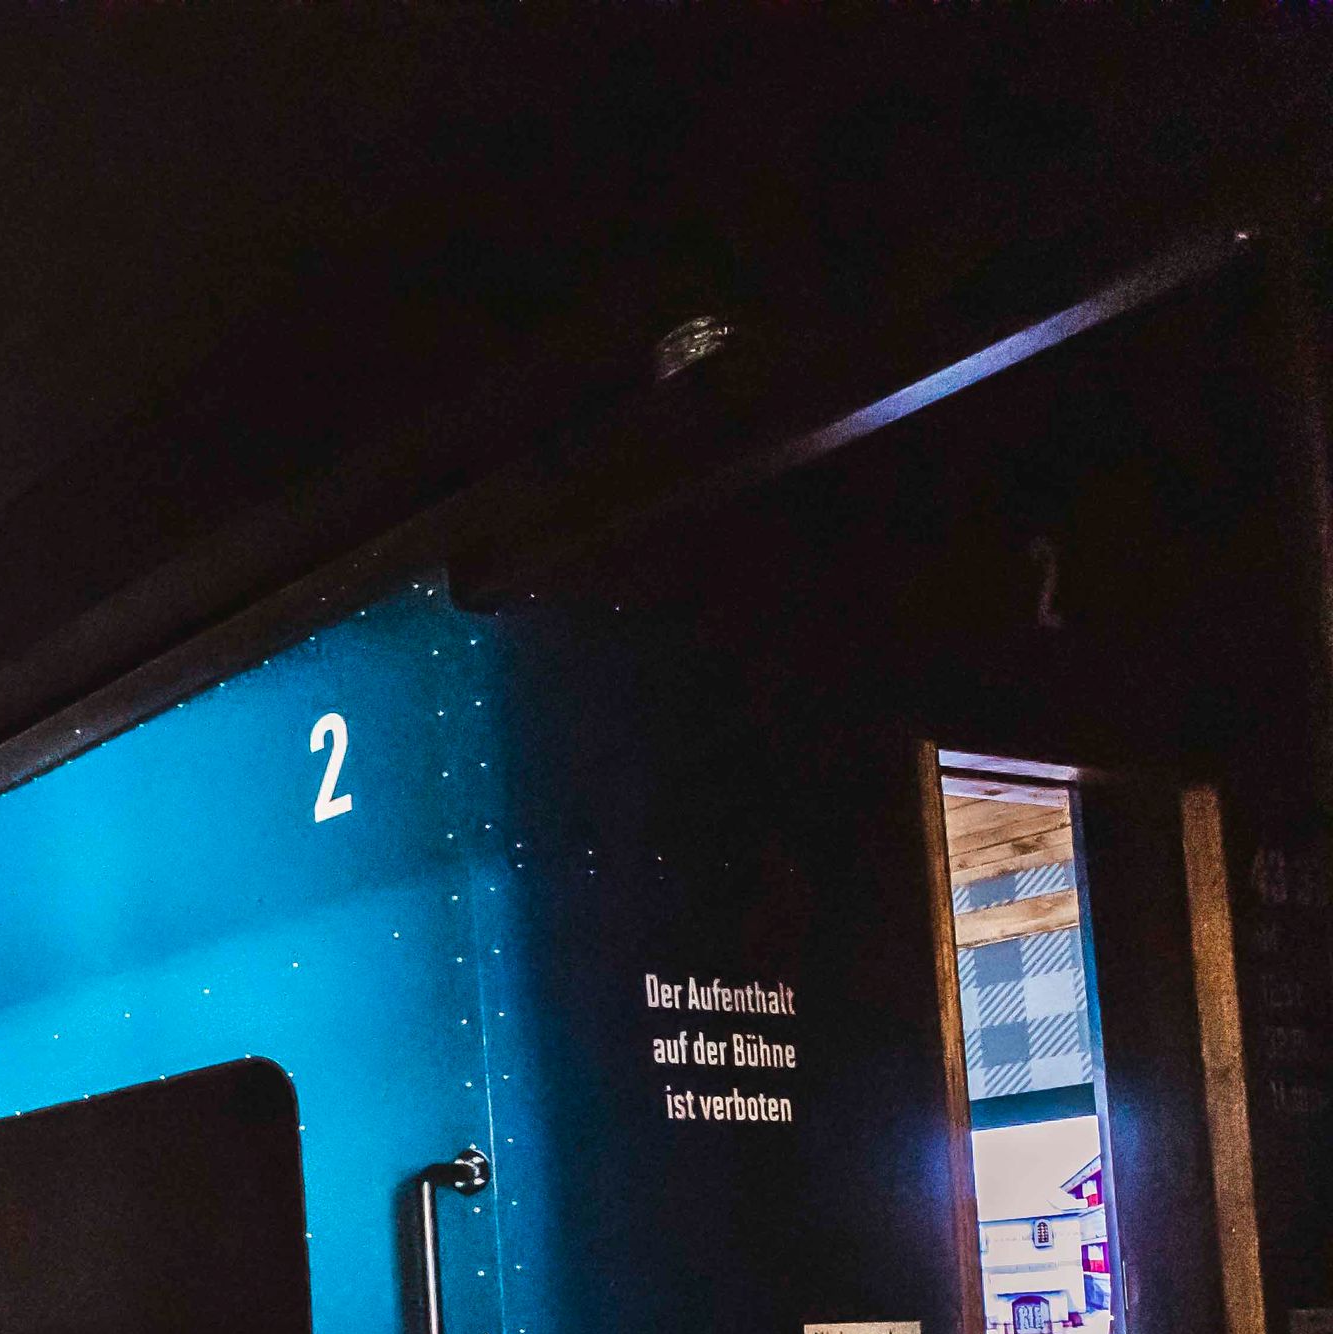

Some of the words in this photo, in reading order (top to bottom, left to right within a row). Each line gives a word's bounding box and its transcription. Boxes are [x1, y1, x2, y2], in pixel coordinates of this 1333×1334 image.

[310, 713, 352, 822] 2
[645, 973, 683, 1010] Der
[688, 976, 796, 1015] Aufenthalt
[653, 1031, 688, 1064] auf
[693, 1032, 727, 1066] der
[733, 1033, 796, 1068] Bühne
[664, 1084, 696, 1120] ist
[699, 1087, 792, 1122] verboten
